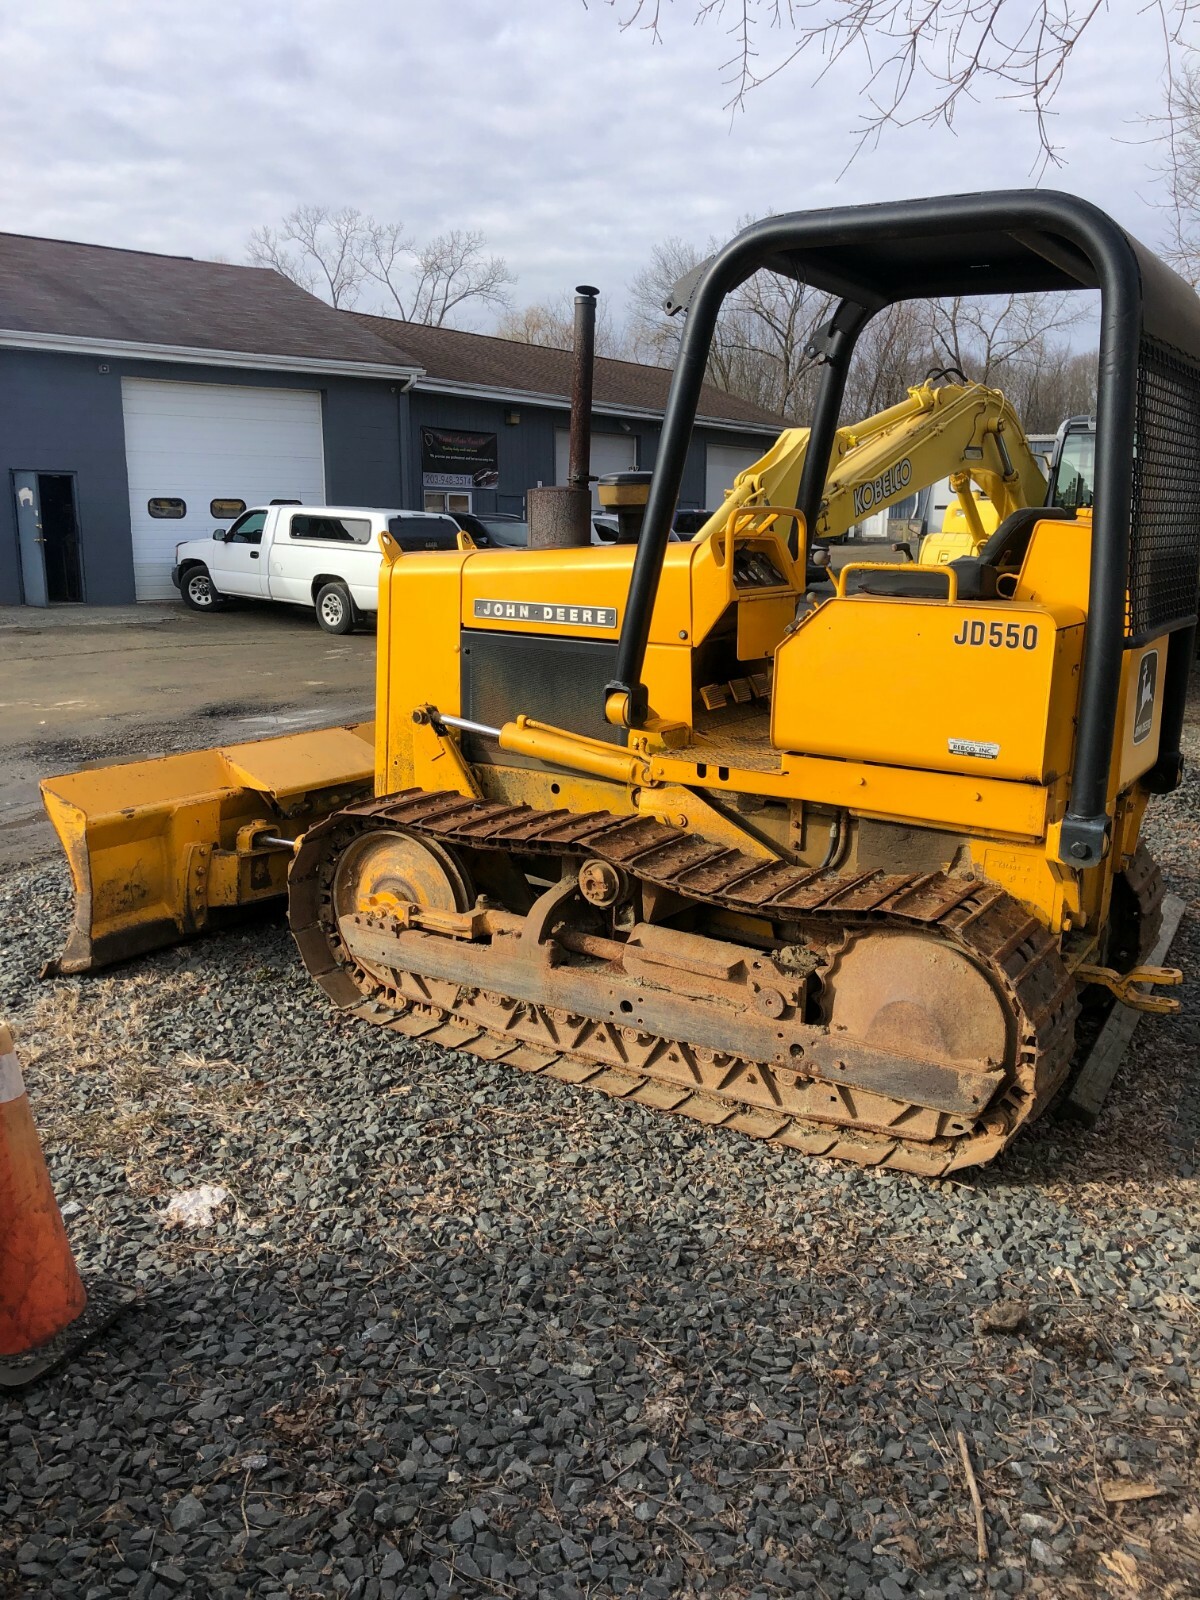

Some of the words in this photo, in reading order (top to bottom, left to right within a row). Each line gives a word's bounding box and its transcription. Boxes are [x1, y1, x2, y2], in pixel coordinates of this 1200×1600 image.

[425, 474, 471, 485] 203-948-3514
[853, 458, 912, 518] KOBELCO
[483, 603, 529, 618] JOHN
[543, 607, 606, 624] DEERE
[954, 620, 1038, 650] JD550
